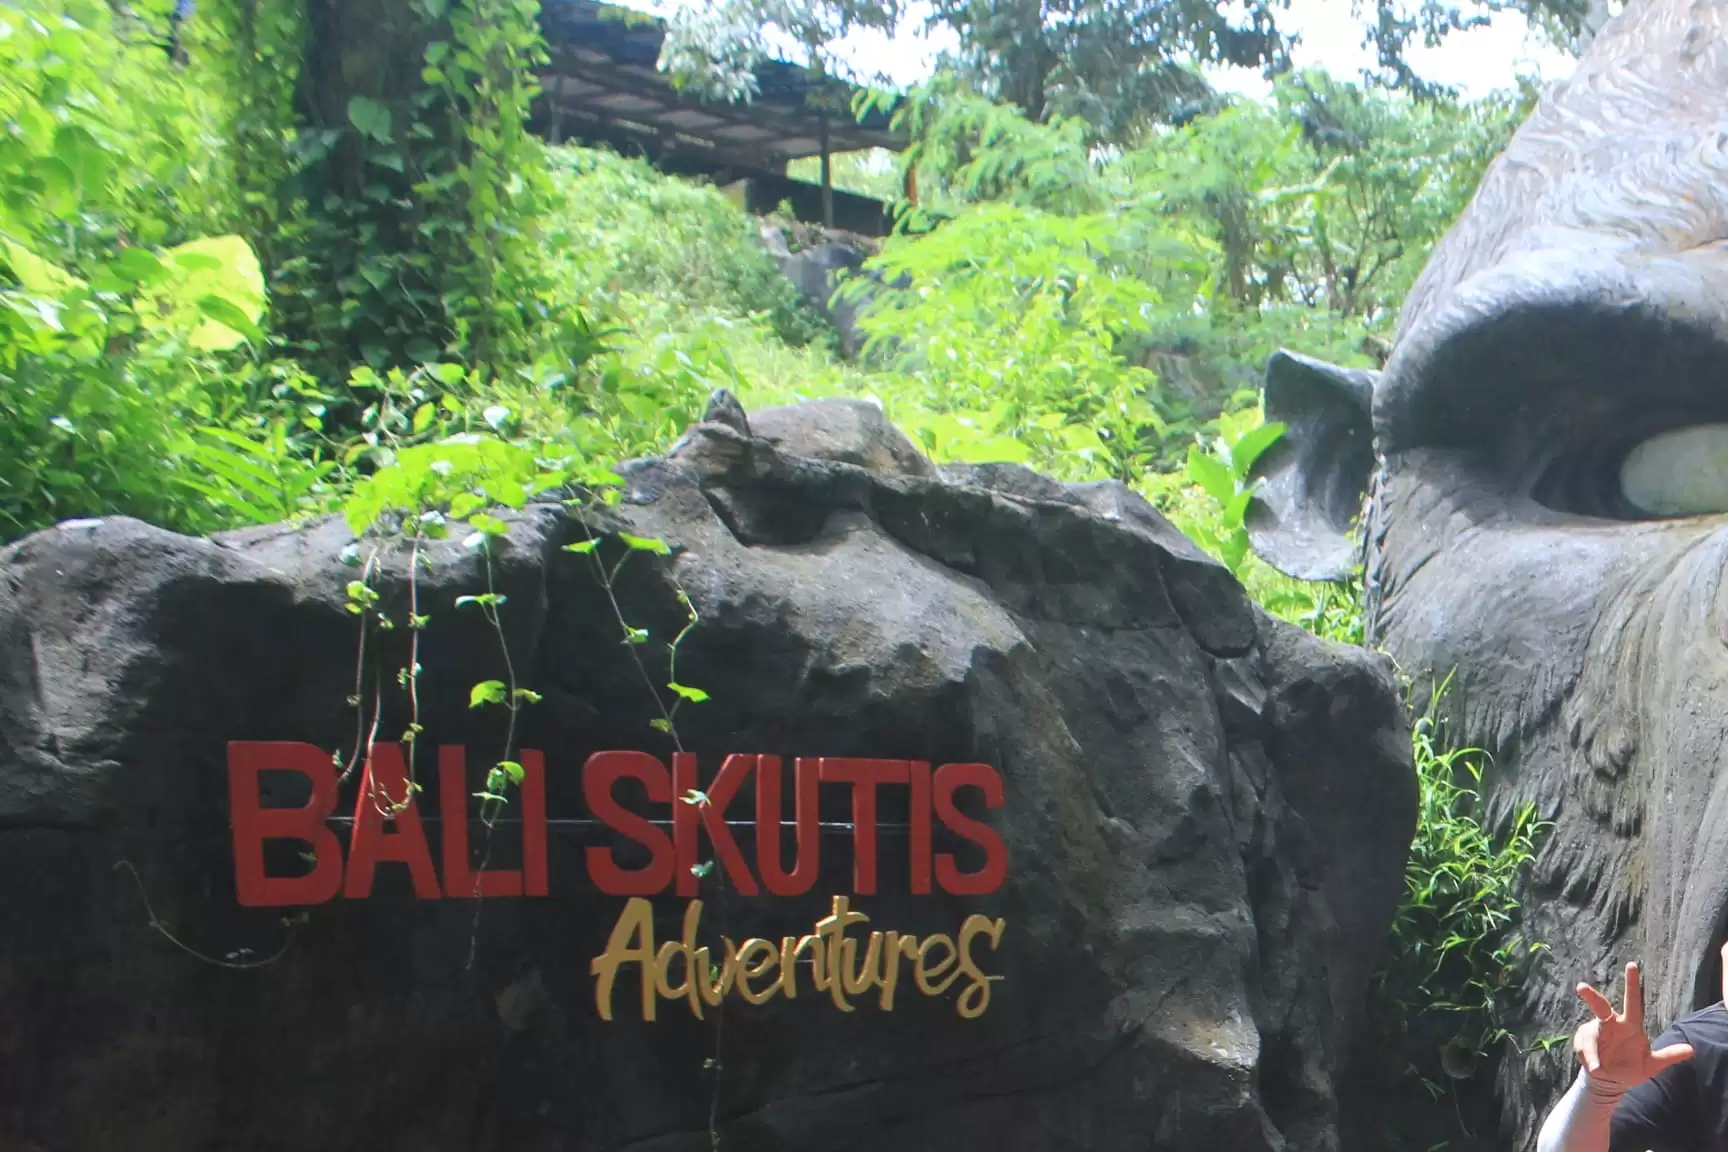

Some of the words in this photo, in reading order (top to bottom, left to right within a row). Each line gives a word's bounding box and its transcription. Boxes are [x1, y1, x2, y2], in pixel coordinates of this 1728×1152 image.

[227, 740, 548, 906] BALI
[582, 750, 1008, 897] SKUTIS
[590, 895, 1006, 1021] Adventures
